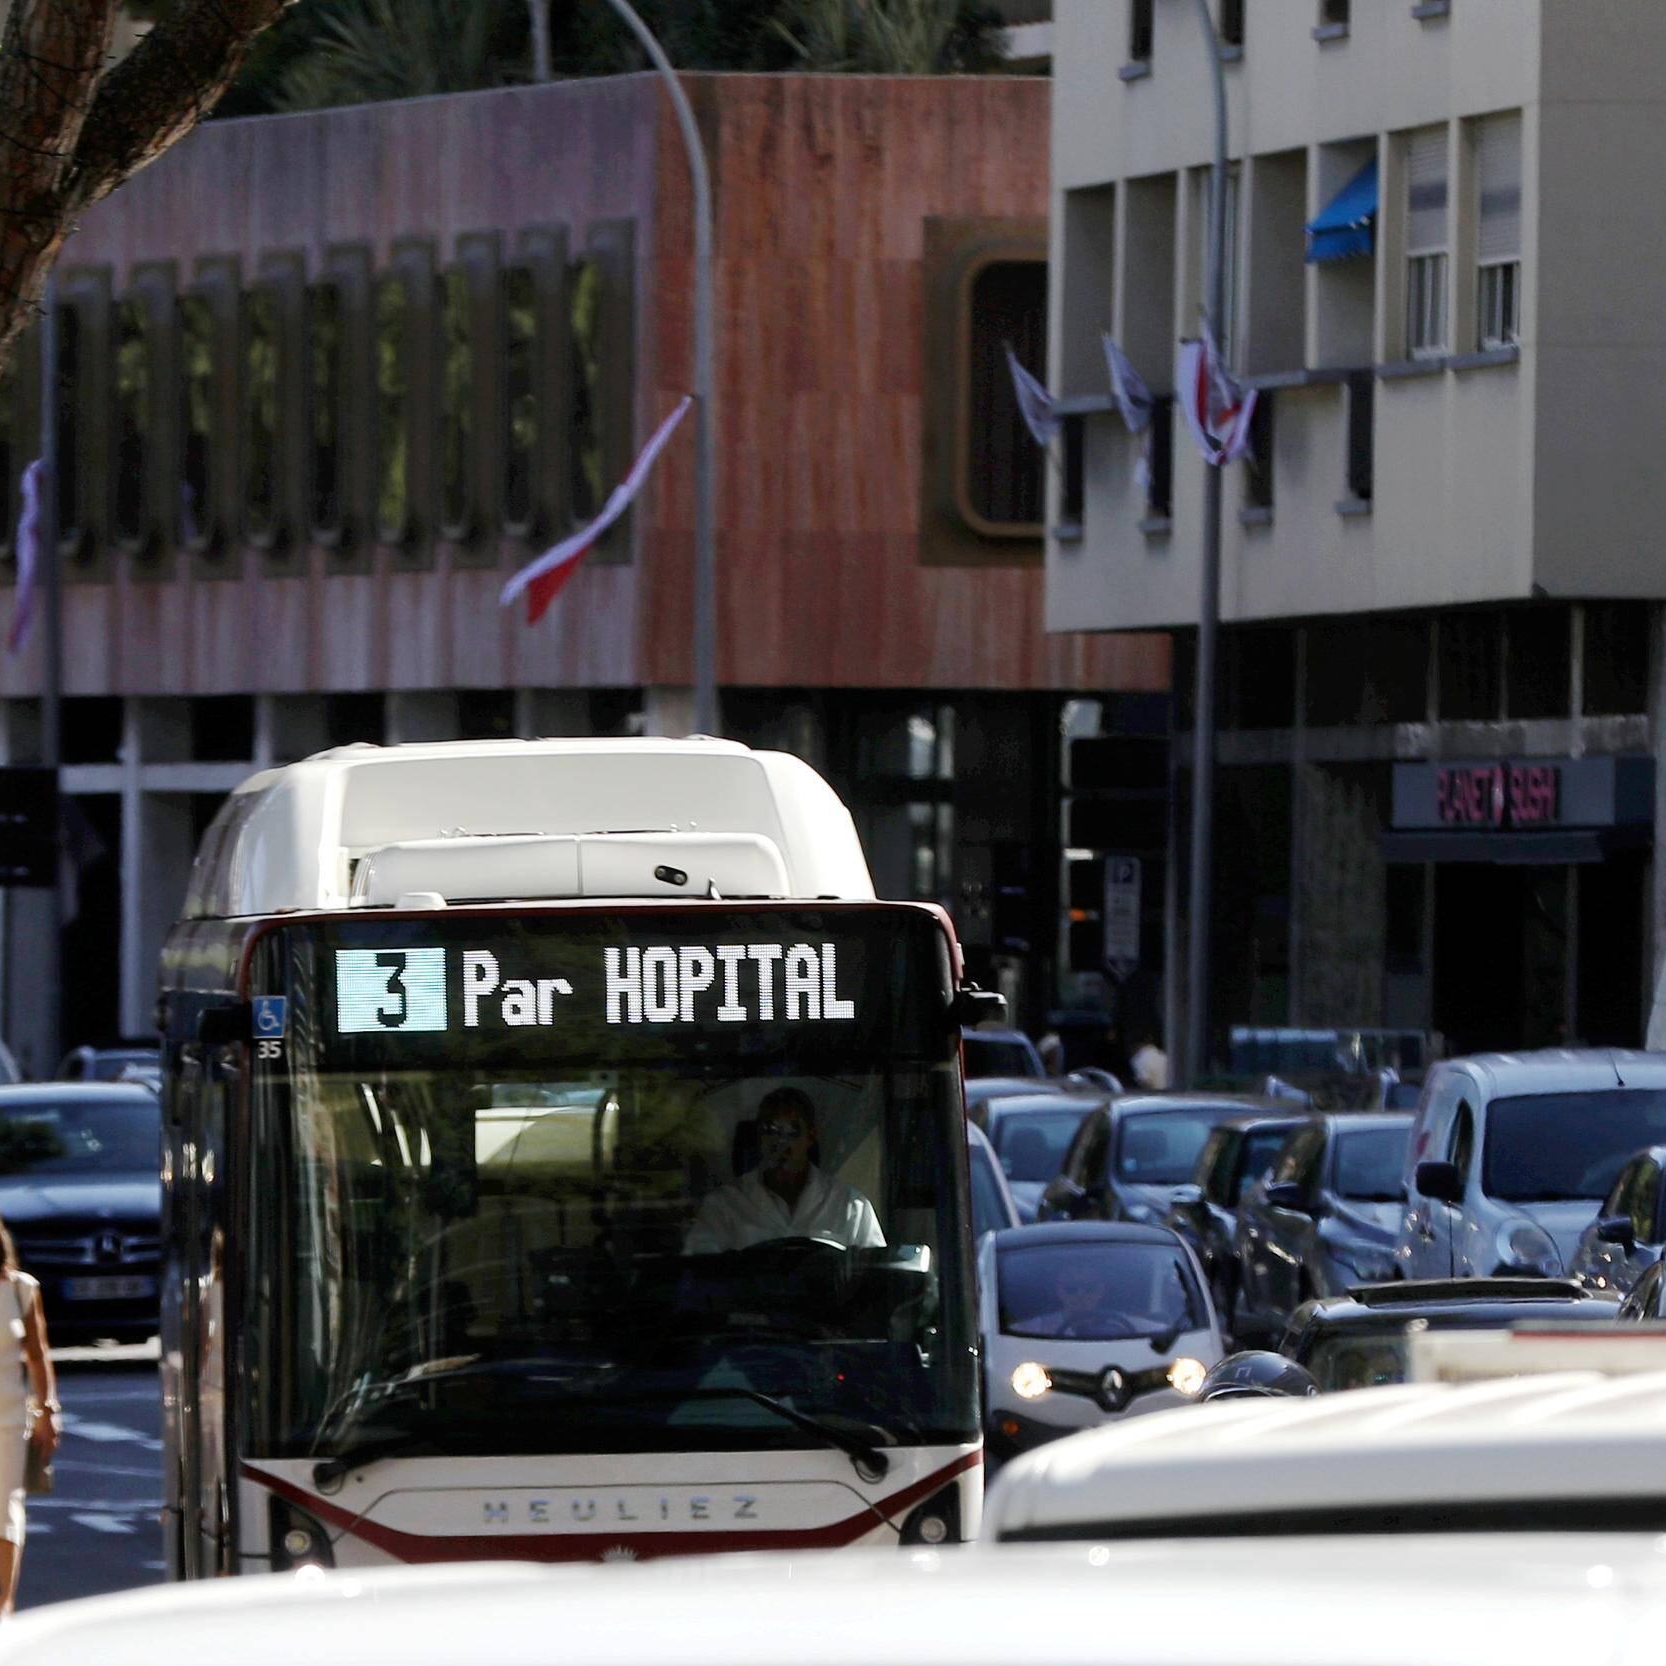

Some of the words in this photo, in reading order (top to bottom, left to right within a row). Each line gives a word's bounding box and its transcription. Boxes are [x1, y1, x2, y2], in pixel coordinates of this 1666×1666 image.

[375, 951, 409, 1029] 3
[462, 949, 574, 1028] Par
[603, 942, 856, 1025] HOPITAL
[257, 1040, 282, 1060] 35
[483, 1495, 759, 1524] HEULIEZ
